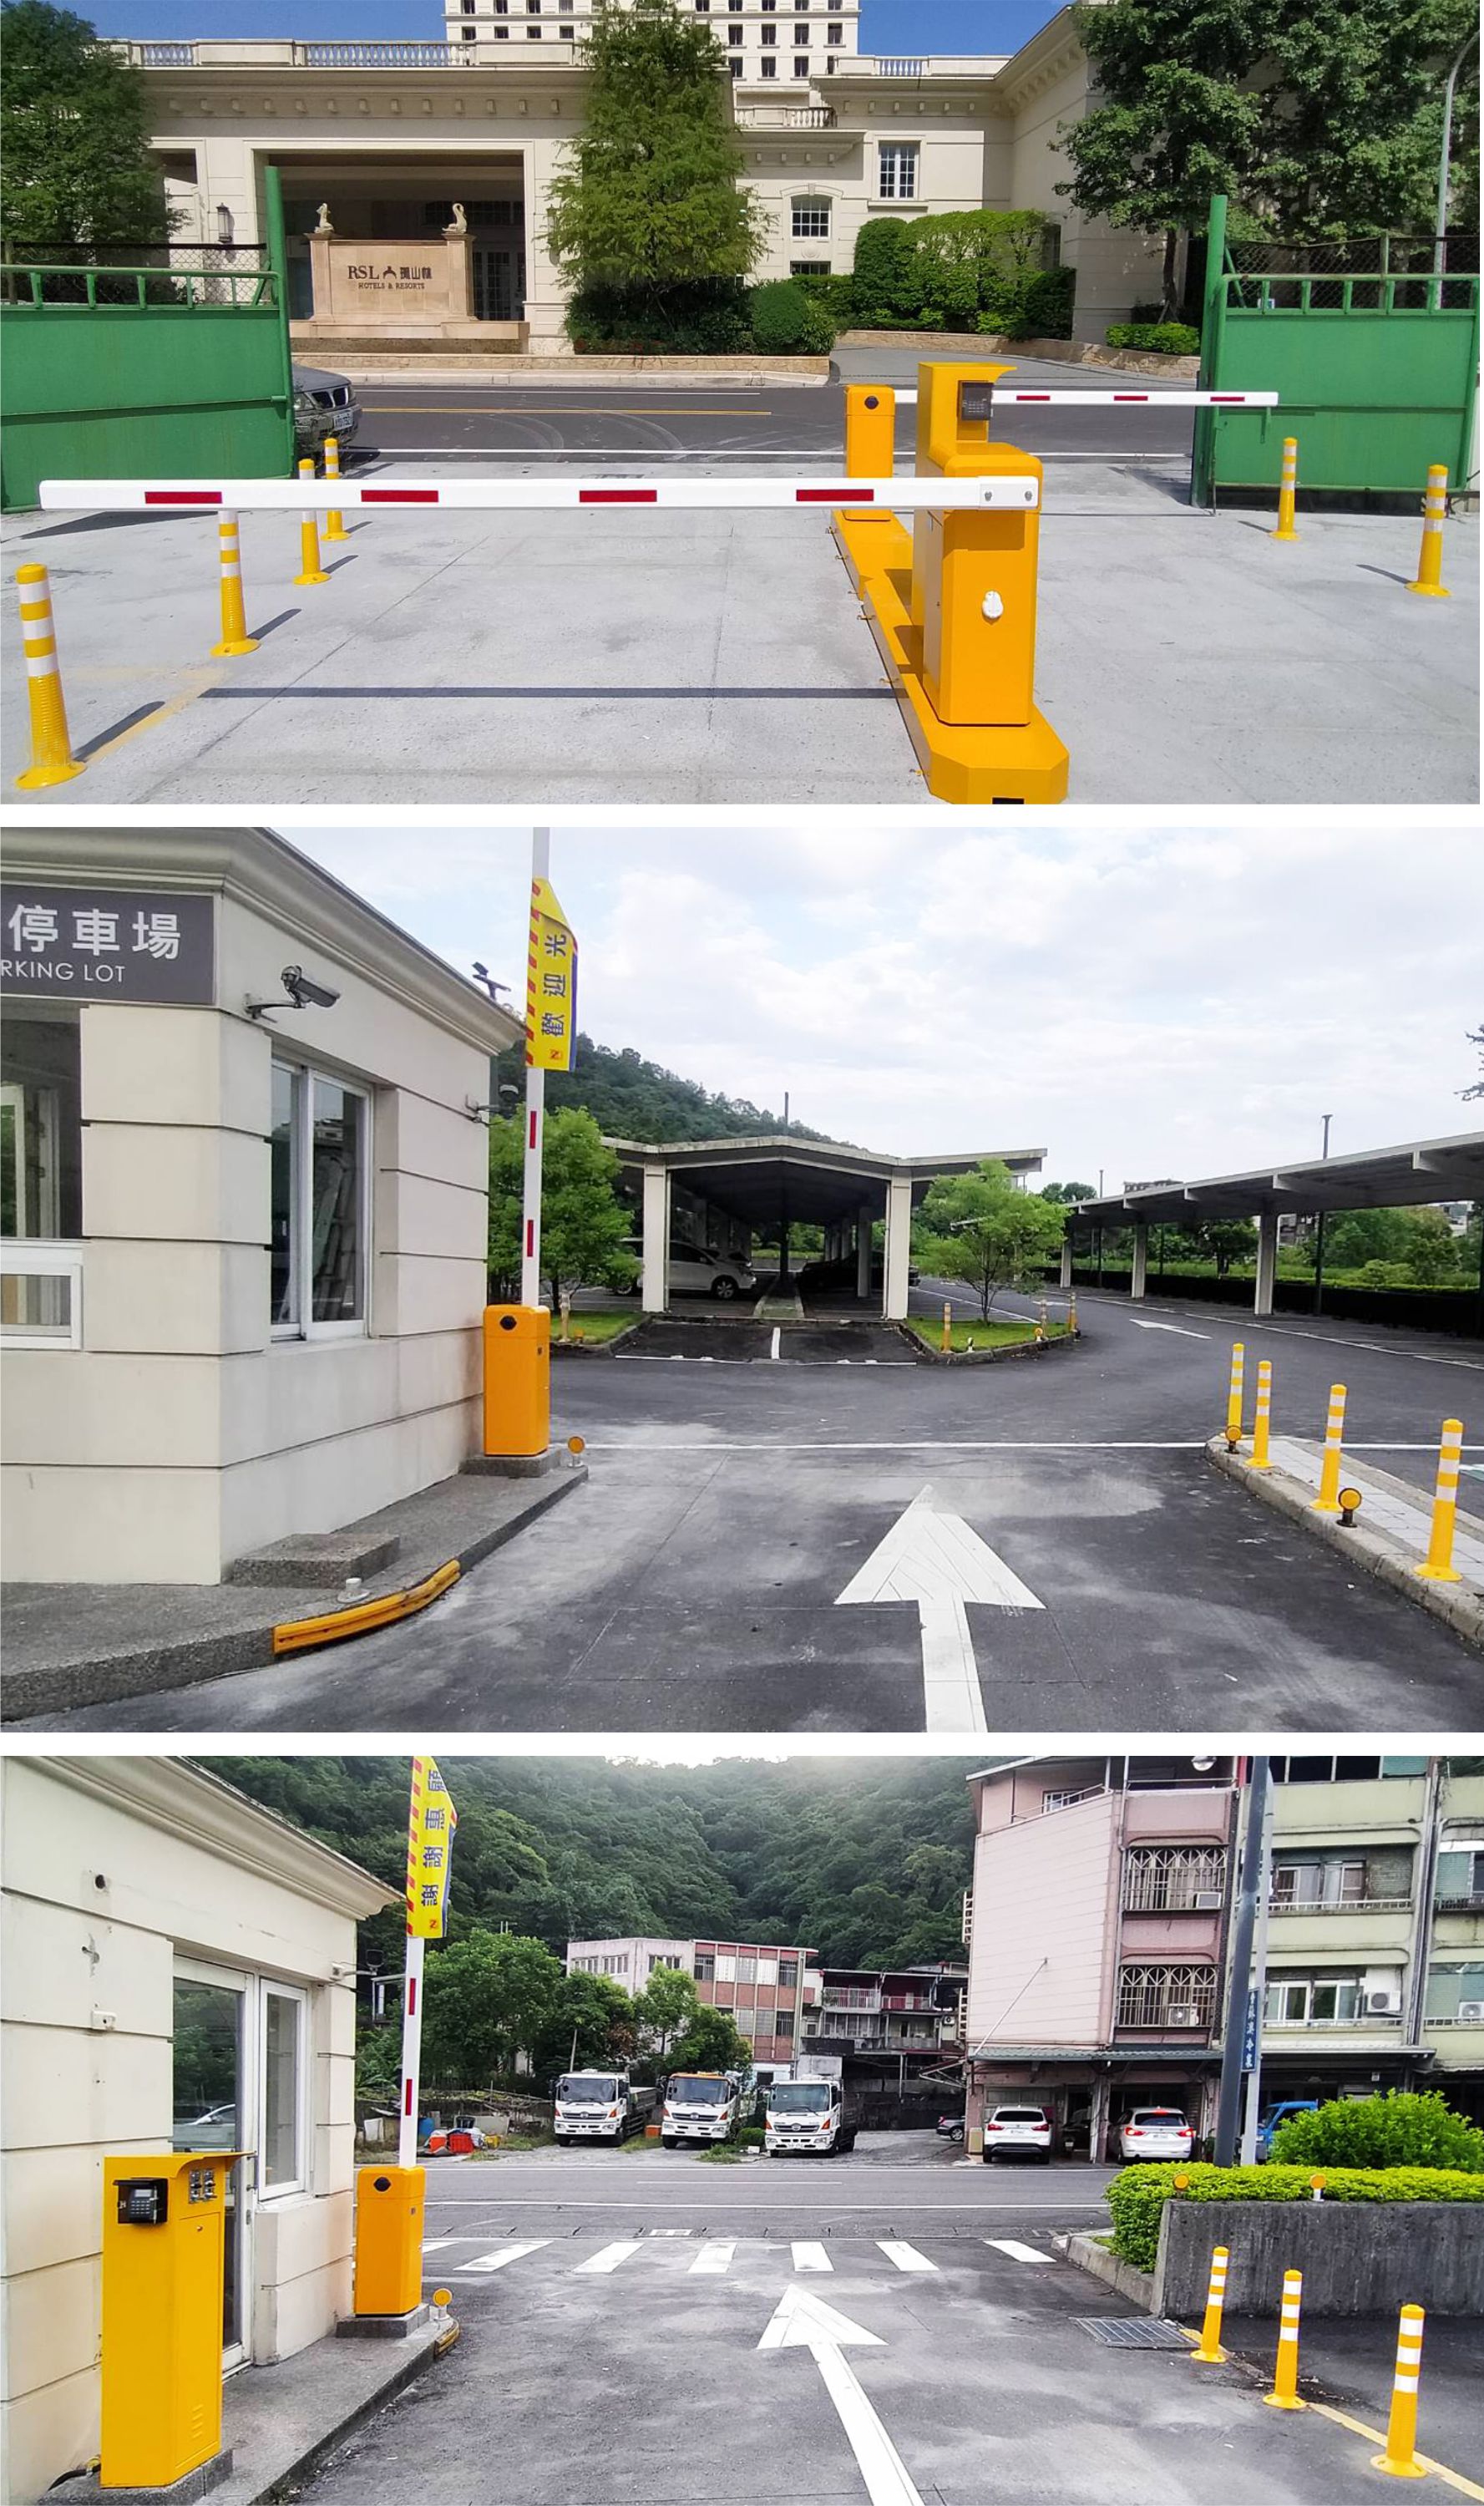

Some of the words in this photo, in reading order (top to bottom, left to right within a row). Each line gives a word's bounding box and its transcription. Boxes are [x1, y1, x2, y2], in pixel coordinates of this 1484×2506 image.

[347, 265, 379, 280] RSL
[8, 903, 181, 961] 停車場
[84, 964, 126, 983] LOT
